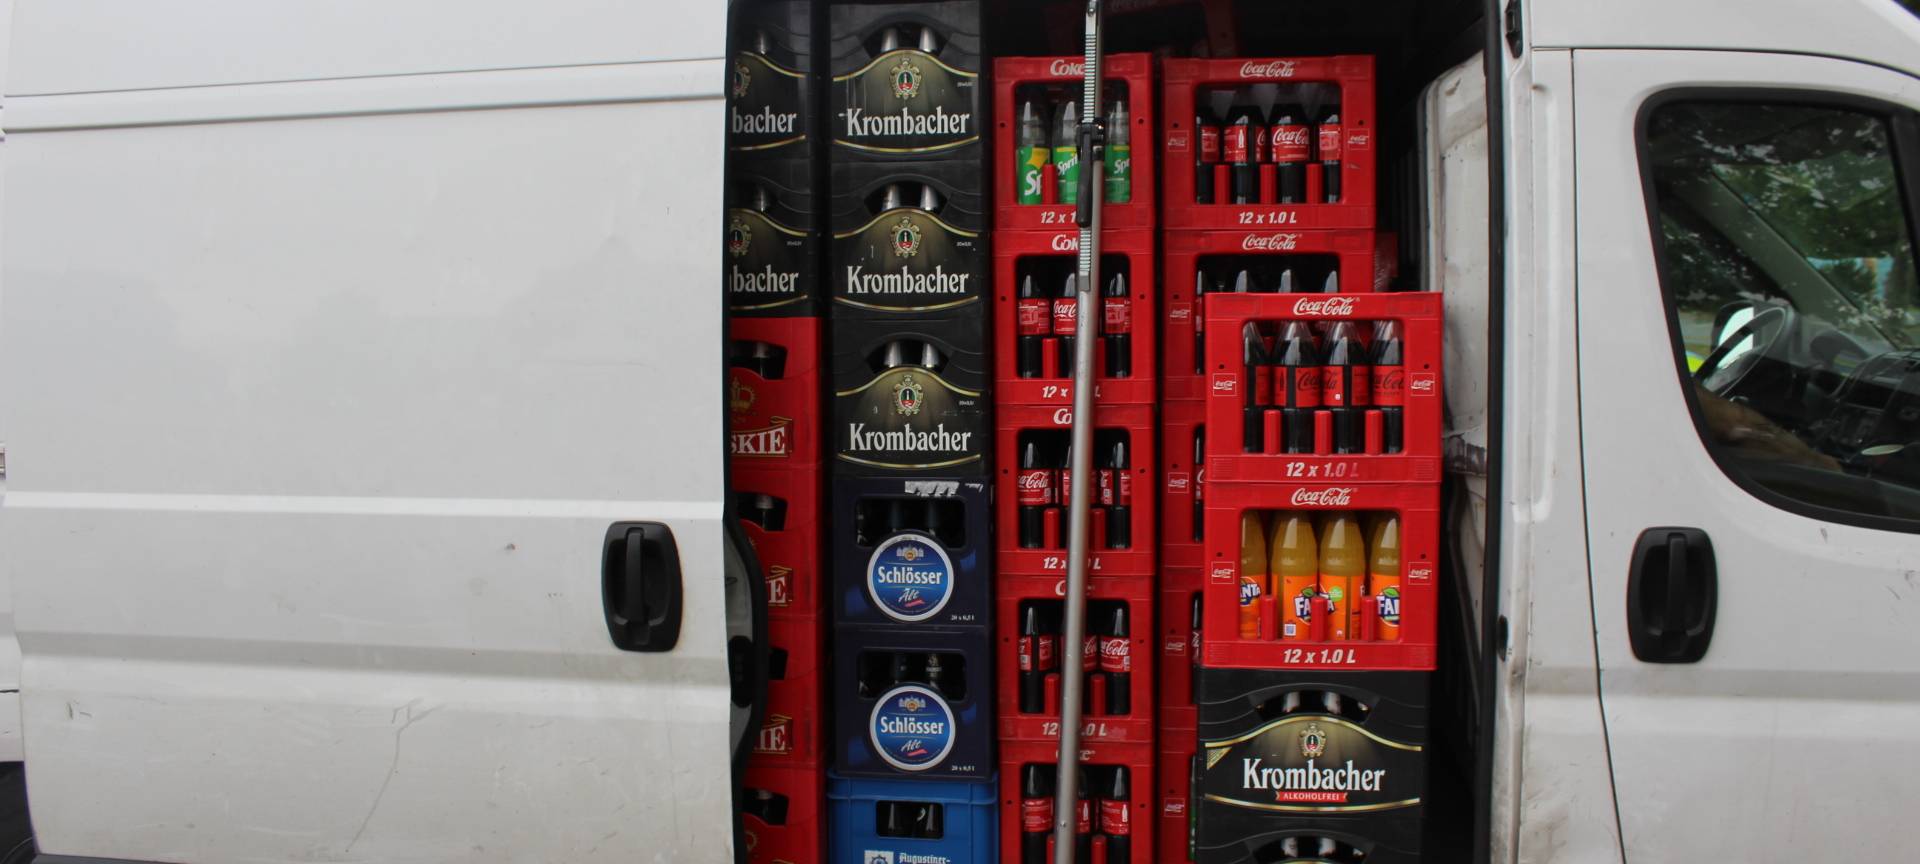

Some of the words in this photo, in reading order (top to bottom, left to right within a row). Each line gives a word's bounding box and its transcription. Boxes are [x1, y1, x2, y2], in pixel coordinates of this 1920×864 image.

[1240, 61, 1297, 79] Coca-Cola
[847, 105, 970, 137] Krombacher
[1041, 211, 1056, 224] 12
[1058, 214, 1066, 224] x
[1239, 212, 1252, 225] 12
[1256, 214, 1265, 225] x
[1269, 212, 1286, 225] 1.0
[1290, 212, 1297, 225] L
[1242, 233, 1298, 250] Coca-Cola
[847, 264, 969, 294] Krombacher
[1293, 296, 1354, 317] Coca-Cola
[1042, 385, 1057, 399] 12
[1060, 388, 1069, 398] x
[849, 423, 972, 452] Krombacher
[1286, 462, 1305, 477] 12
[1307, 465, 1319, 477] x
[1324, 462, 1347, 477] 1.0
[1350, 462, 1359, 477] L
[1291, 487, 1352, 506] Coca-Cola
[1043, 557, 1058, 569] 12
[1093, 558, 1101, 570] L
[878, 566, 943, 584] Schlösser
[898, 588, 920, 602] Alt
[1283, 649, 1303, 664] 12
[1306, 652, 1317, 664] x
[1320, 649, 1344, 664] 1.0
[1346, 649, 1357, 664] L
[880, 716, 944, 734] Schlösser
[1042, 722, 1058, 735] 12
[1098, 723, 1107, 737] L
[900, 739, 922, 753] Alt
[1243, 758, 1386, 791] Krombacher
[1283, 792, 1341, 801] ALKOHOLFREI
